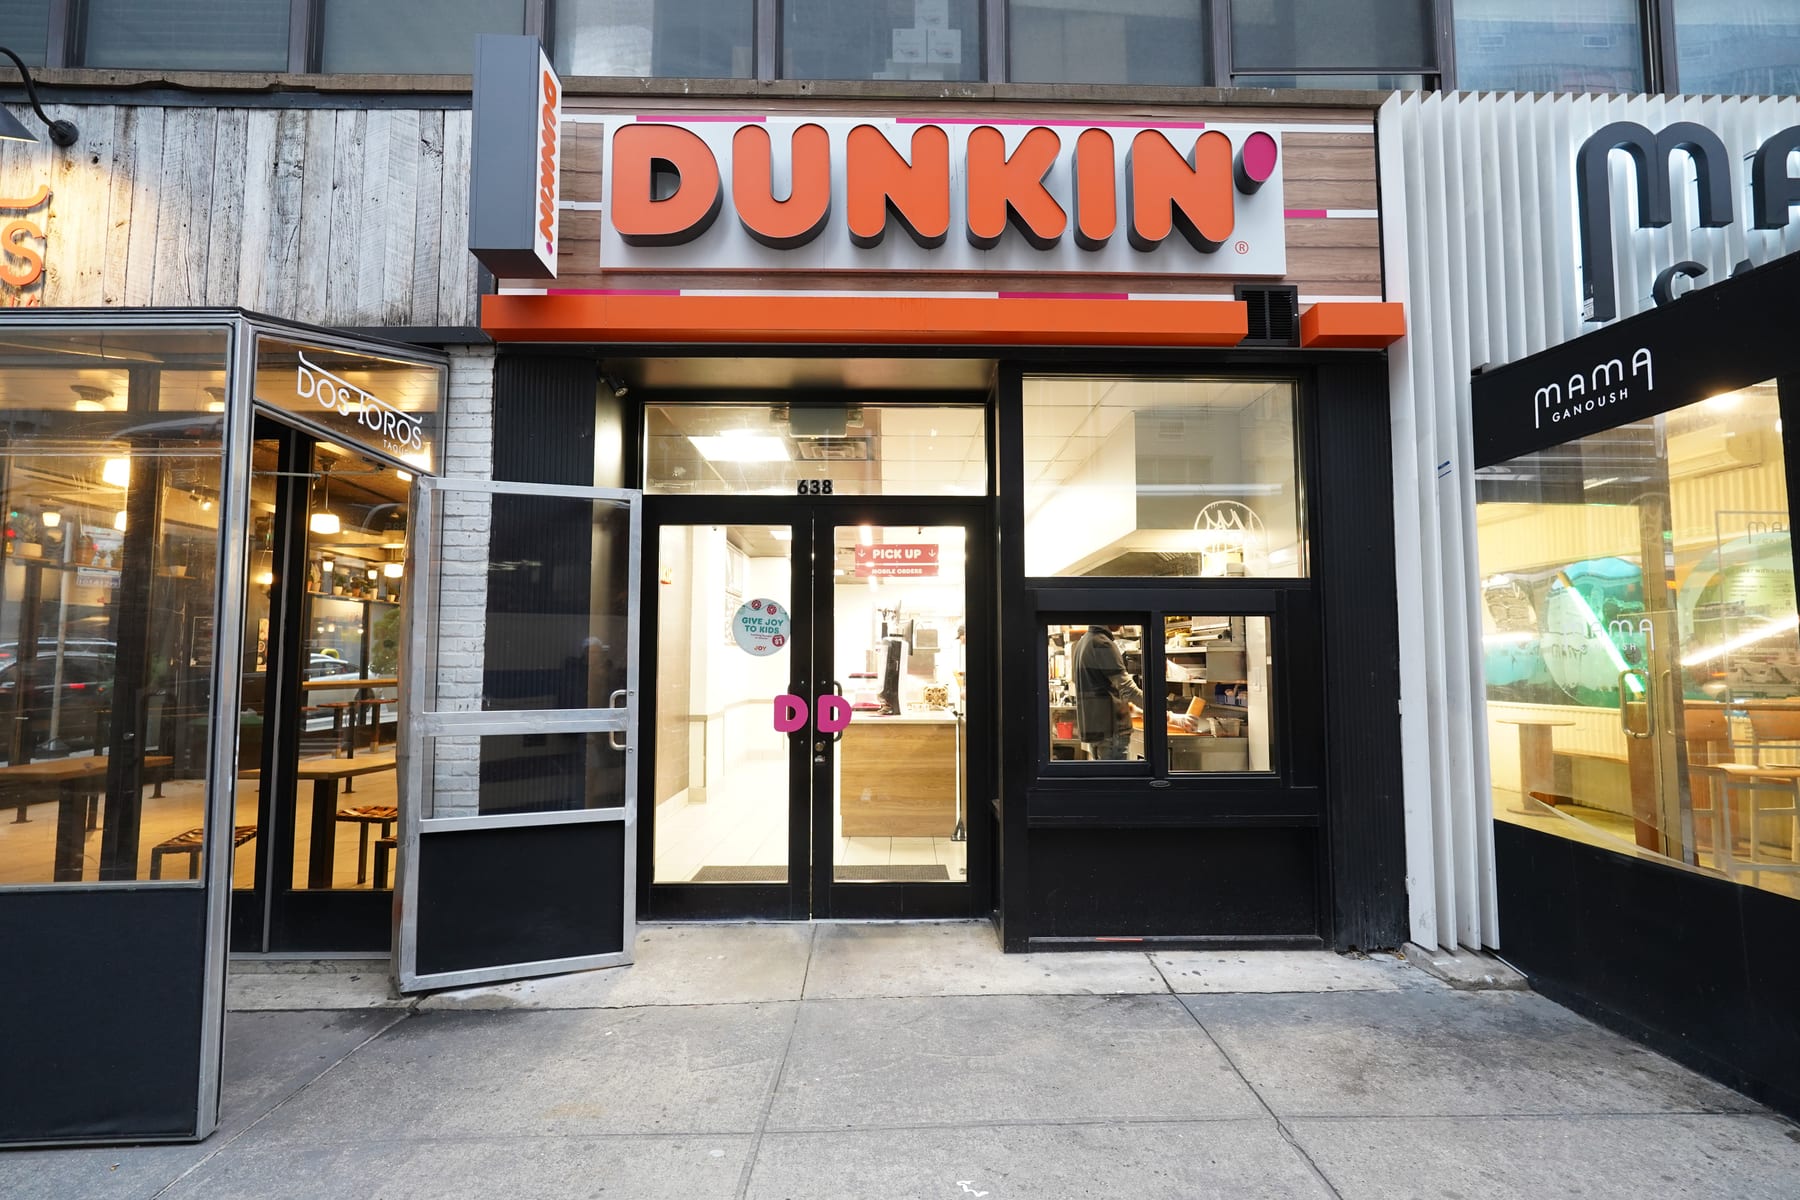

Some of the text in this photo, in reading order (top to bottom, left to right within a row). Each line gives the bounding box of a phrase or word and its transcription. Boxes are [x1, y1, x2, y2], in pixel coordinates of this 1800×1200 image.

[611, 123, 1278, 250] DUNKIN'
[1535, 347, 1653, 429] MAMA
[297, 365, 423, 450] DOS TOROS
[1552, 387, 1628, 423] GANOUSH
[797, 479, 833, 495] 638
[872, 548, 922, 559] PICK UP
[741, 616, 784, 627] GIVE JOY
[744, 624, 780, 634] TO KIDS
